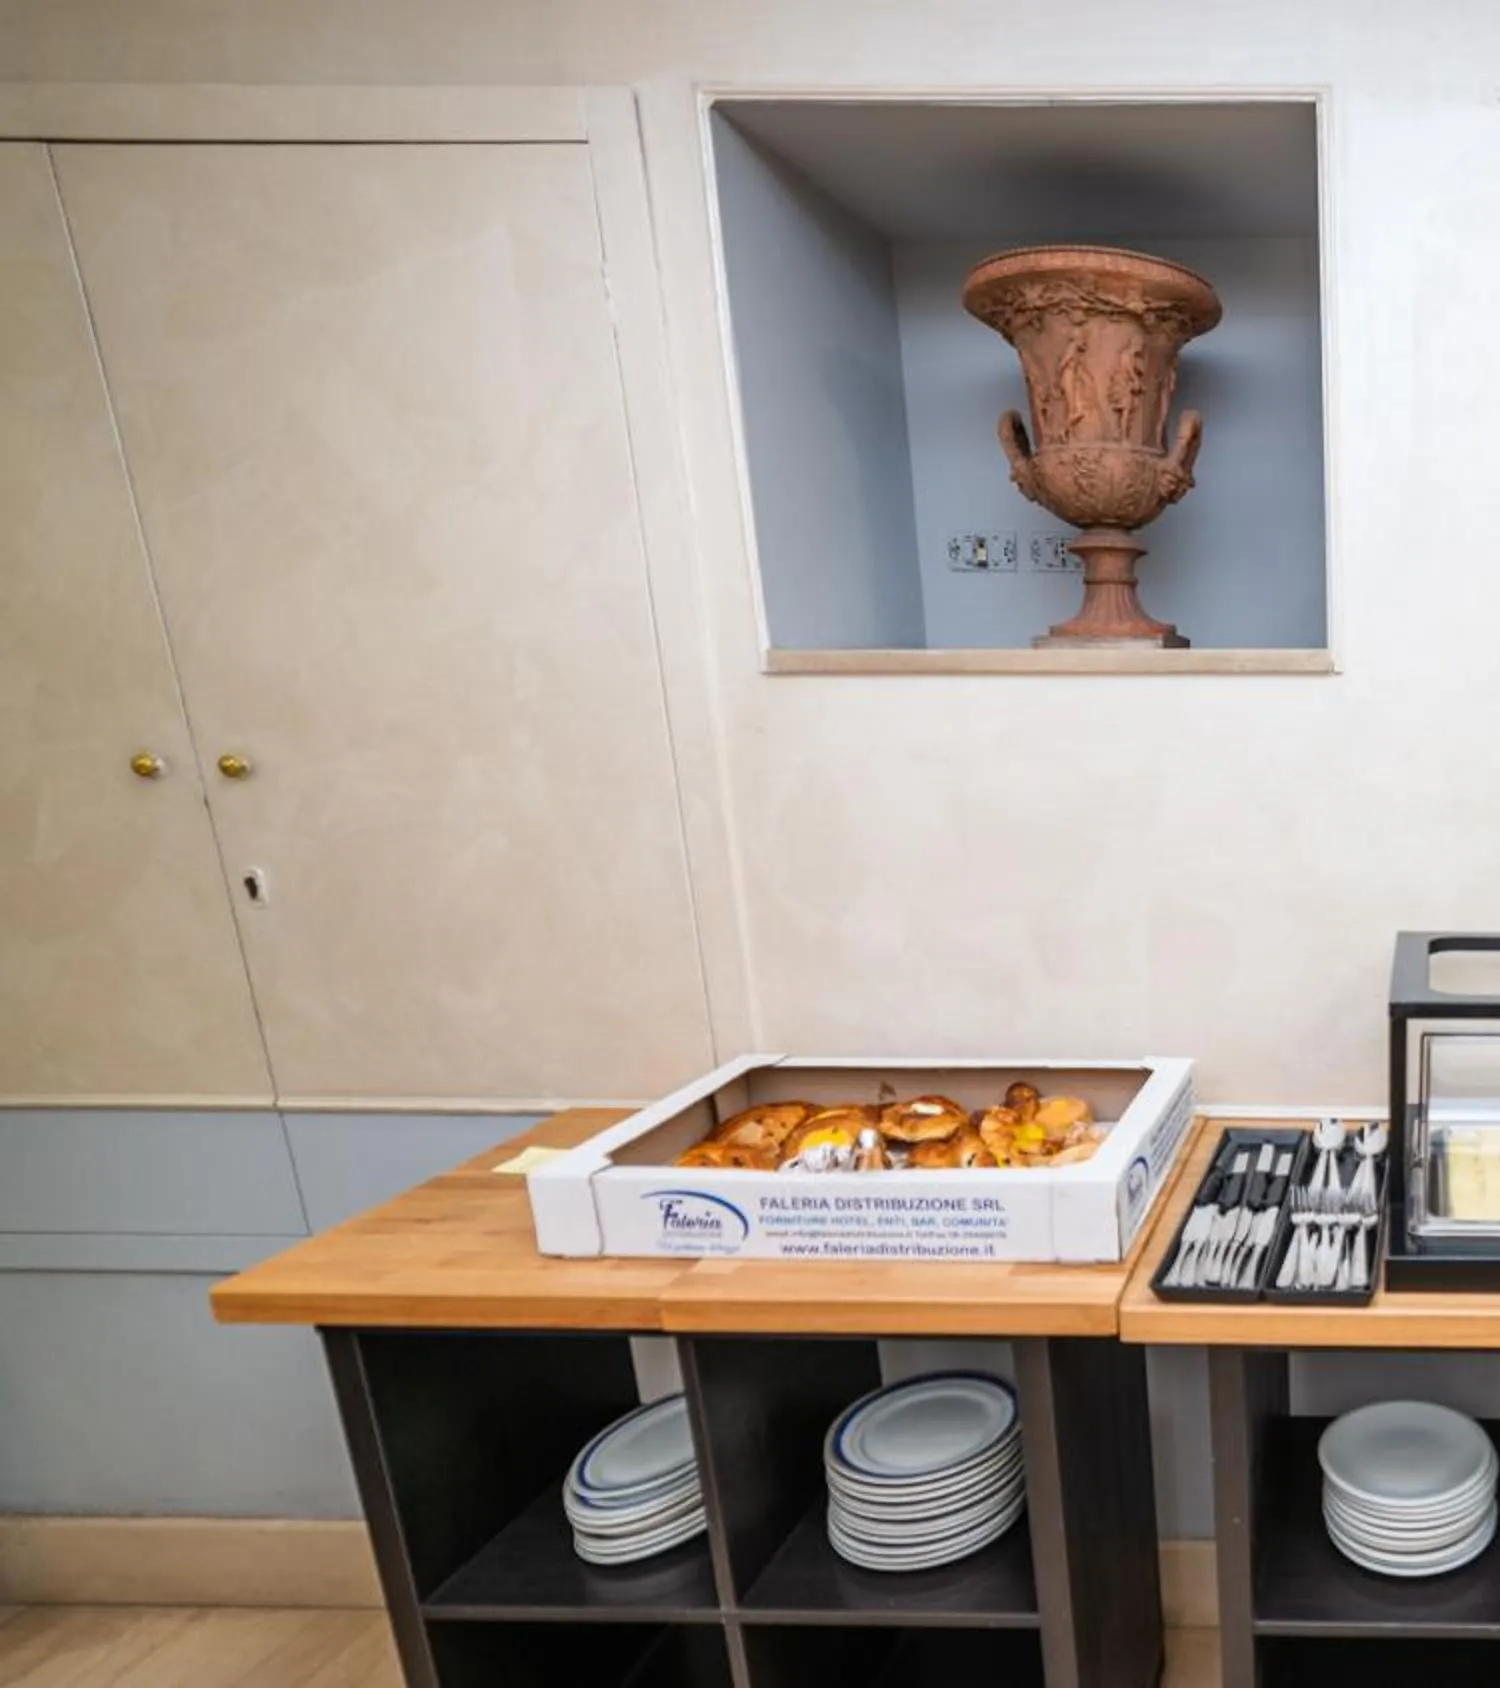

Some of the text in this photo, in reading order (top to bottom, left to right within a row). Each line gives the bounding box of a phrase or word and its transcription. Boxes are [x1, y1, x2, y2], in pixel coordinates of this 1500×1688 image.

[759, 1196, 1006, 1212] FALERIA DISTRIBUZIONE SRL
[781, 1242, 995, 1257] www.faleriadistribuzione.it
